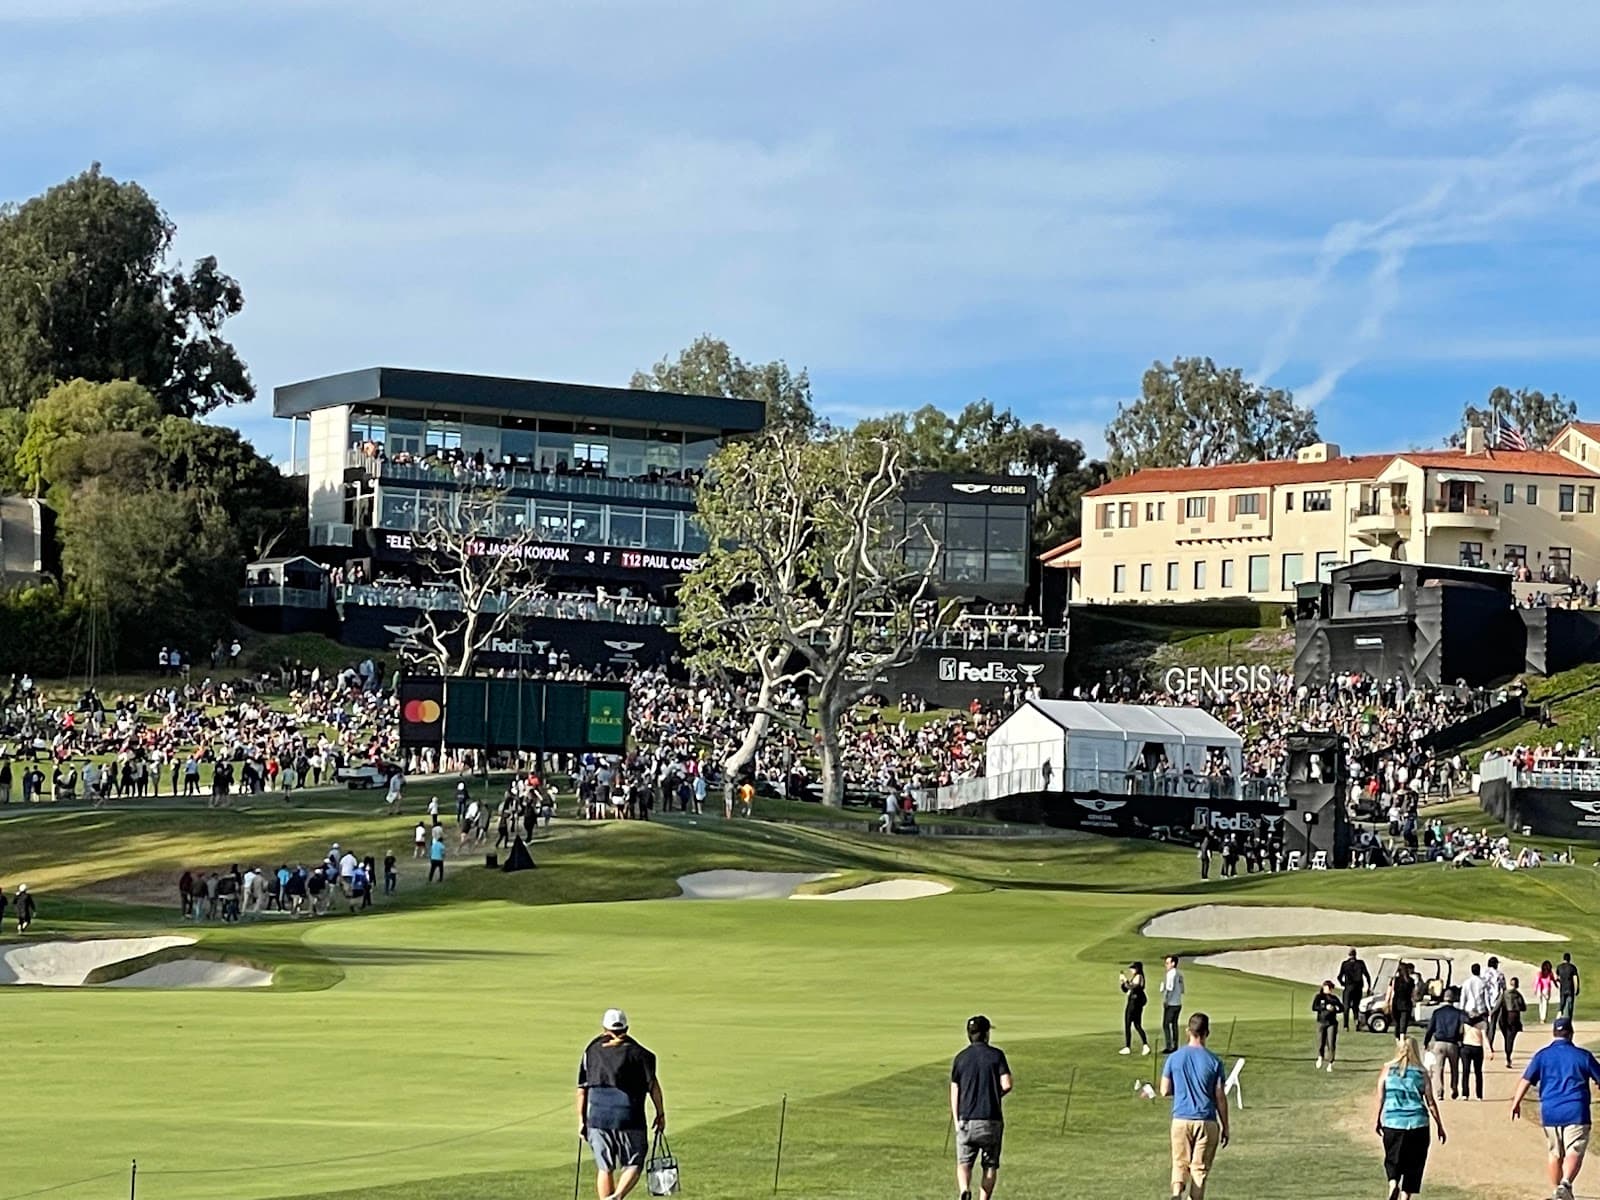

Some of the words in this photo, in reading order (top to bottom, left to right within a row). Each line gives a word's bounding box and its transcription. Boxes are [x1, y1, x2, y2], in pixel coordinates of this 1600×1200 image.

[525, 545, 570, 561] KOKRAK
[602, 551, 612, 564] F
[622, 552, 642, 568] T12
[642, 554, 670, 569] PAUL
[958, 661, 1019, 683] FedEx
[1165, 664, 1272, 697] GENESIS
[1211, 811, 1261, 831] FedEx
